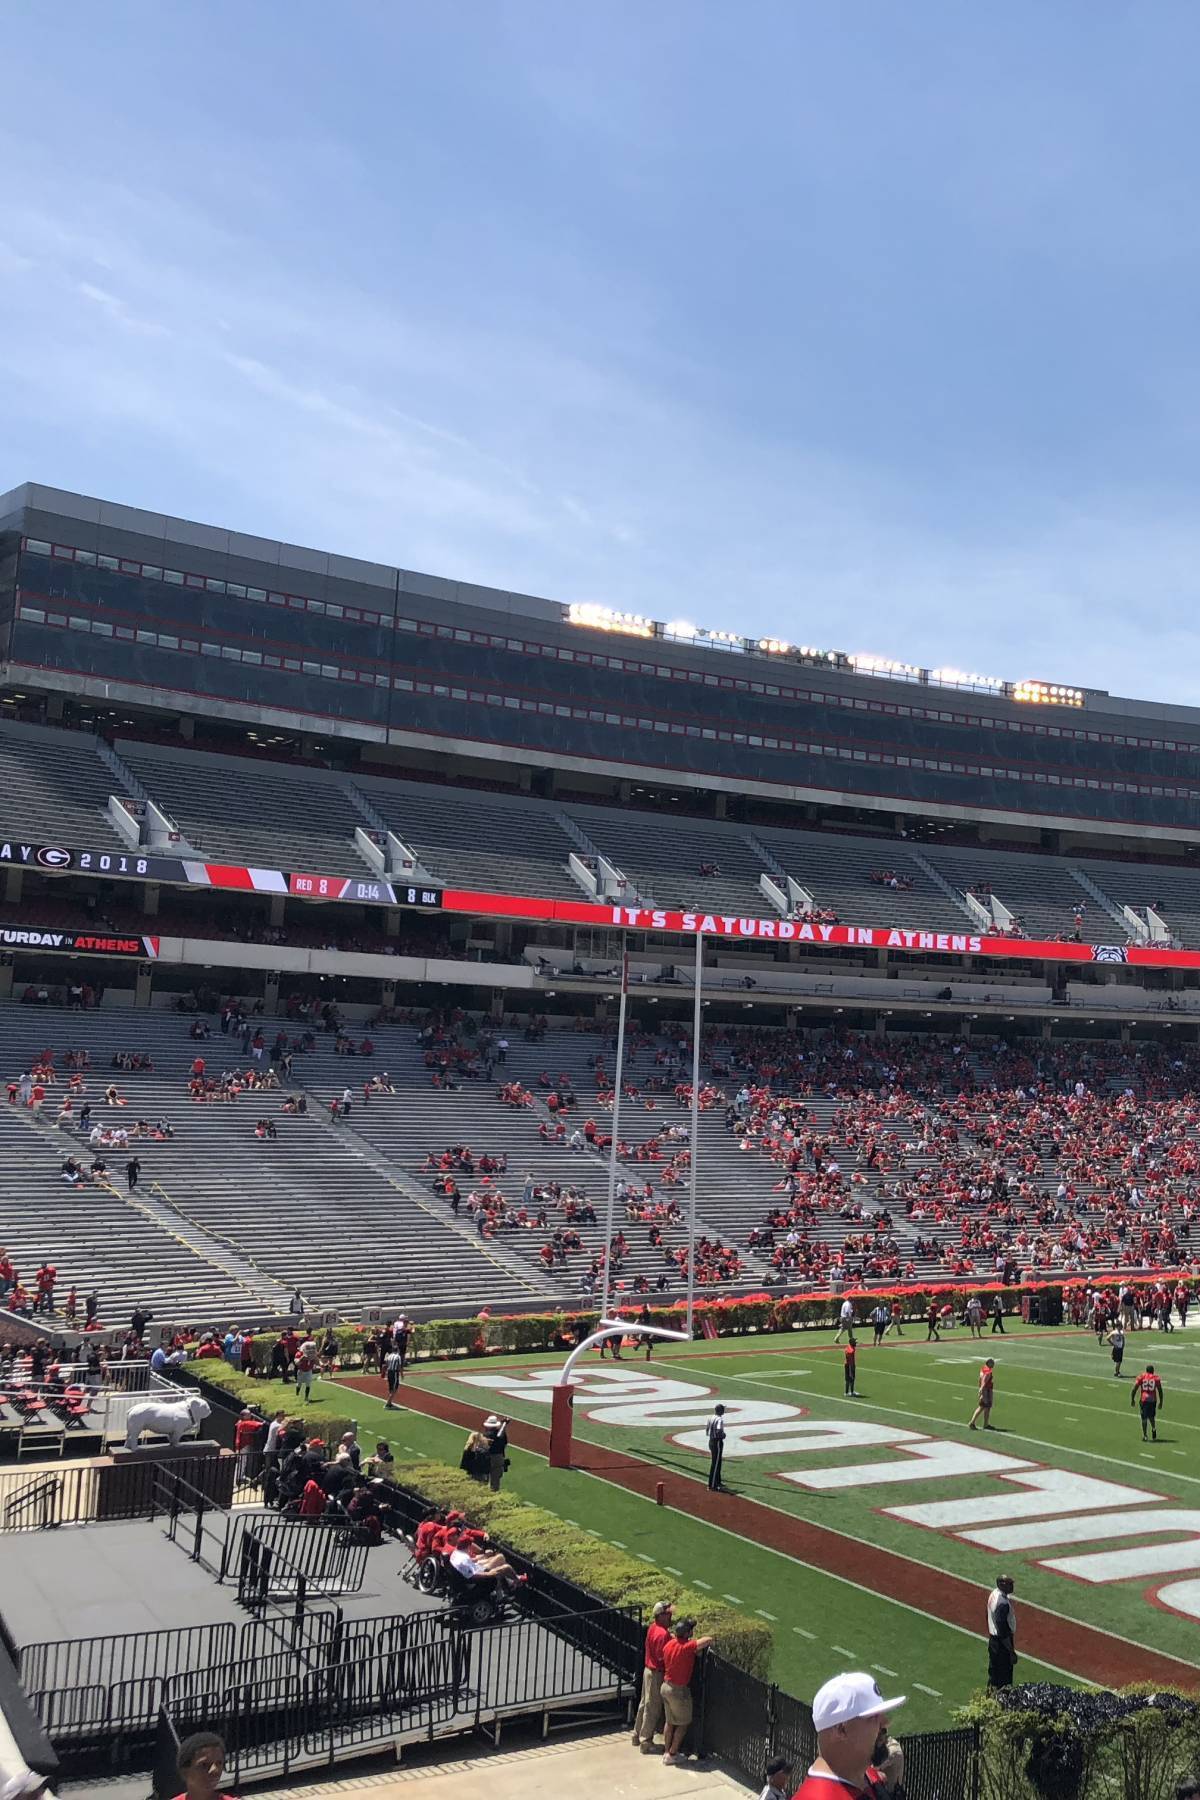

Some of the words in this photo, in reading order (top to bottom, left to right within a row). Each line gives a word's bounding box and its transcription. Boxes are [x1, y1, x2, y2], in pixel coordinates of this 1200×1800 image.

[80, 854, 148, 873] 2018
[296, 879, 312, 891] RED
[319, 880, 328, 893] 8
[357, 884, 379, 899] 0:14
[407, 889, 415, 902] 8
[422, 892, 436, 903] BLK
[612, 907, 666, 928] IT'S
[682, 914, 833, 941] SATURDAY
[847, 928, 873, 944] IN
[887, 931, 982, 951] ATHENS
[65, 937, 73, 945] IN
[74, 937, 139, 951] ATHENS
[1142, 1380, 1155, 1391] 29
